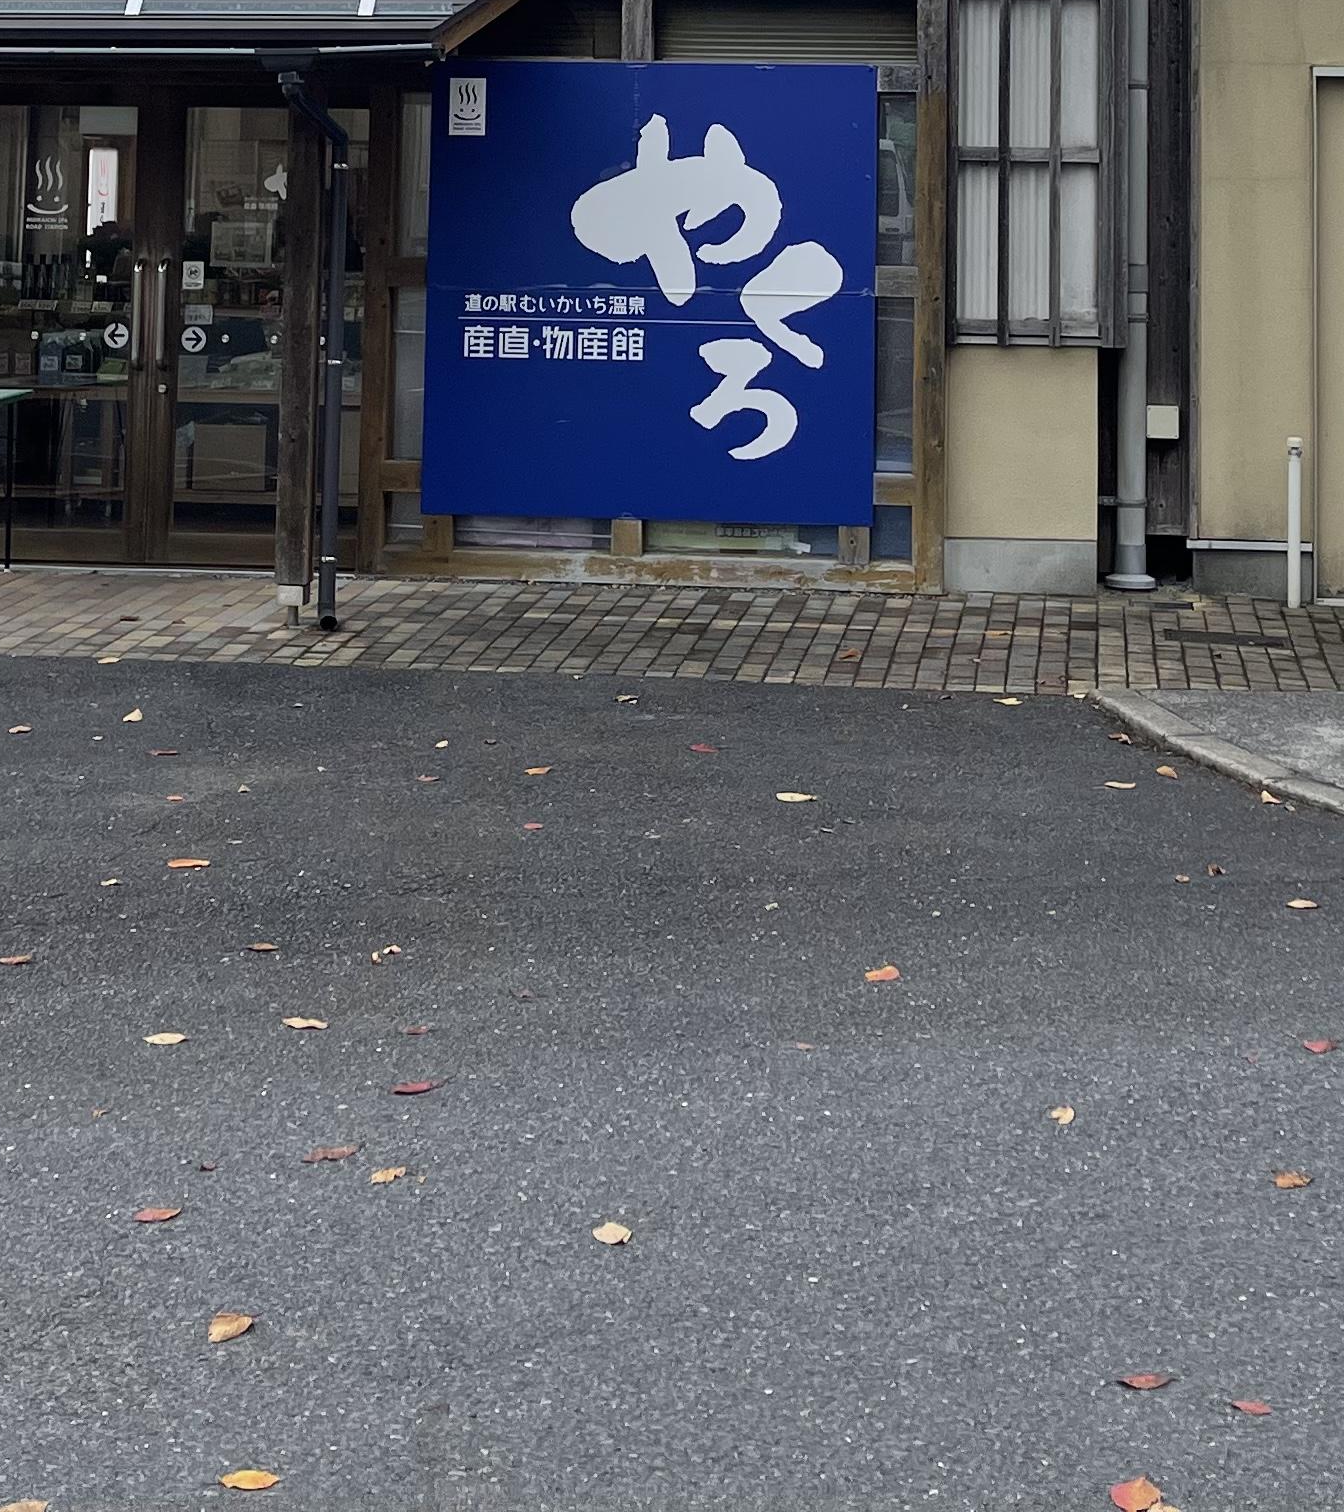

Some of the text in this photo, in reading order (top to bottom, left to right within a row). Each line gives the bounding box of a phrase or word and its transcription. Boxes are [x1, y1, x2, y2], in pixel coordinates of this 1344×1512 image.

[464, 325, 645, 361] 産直・物産館
[571, 113, 843, 460] やくろ
